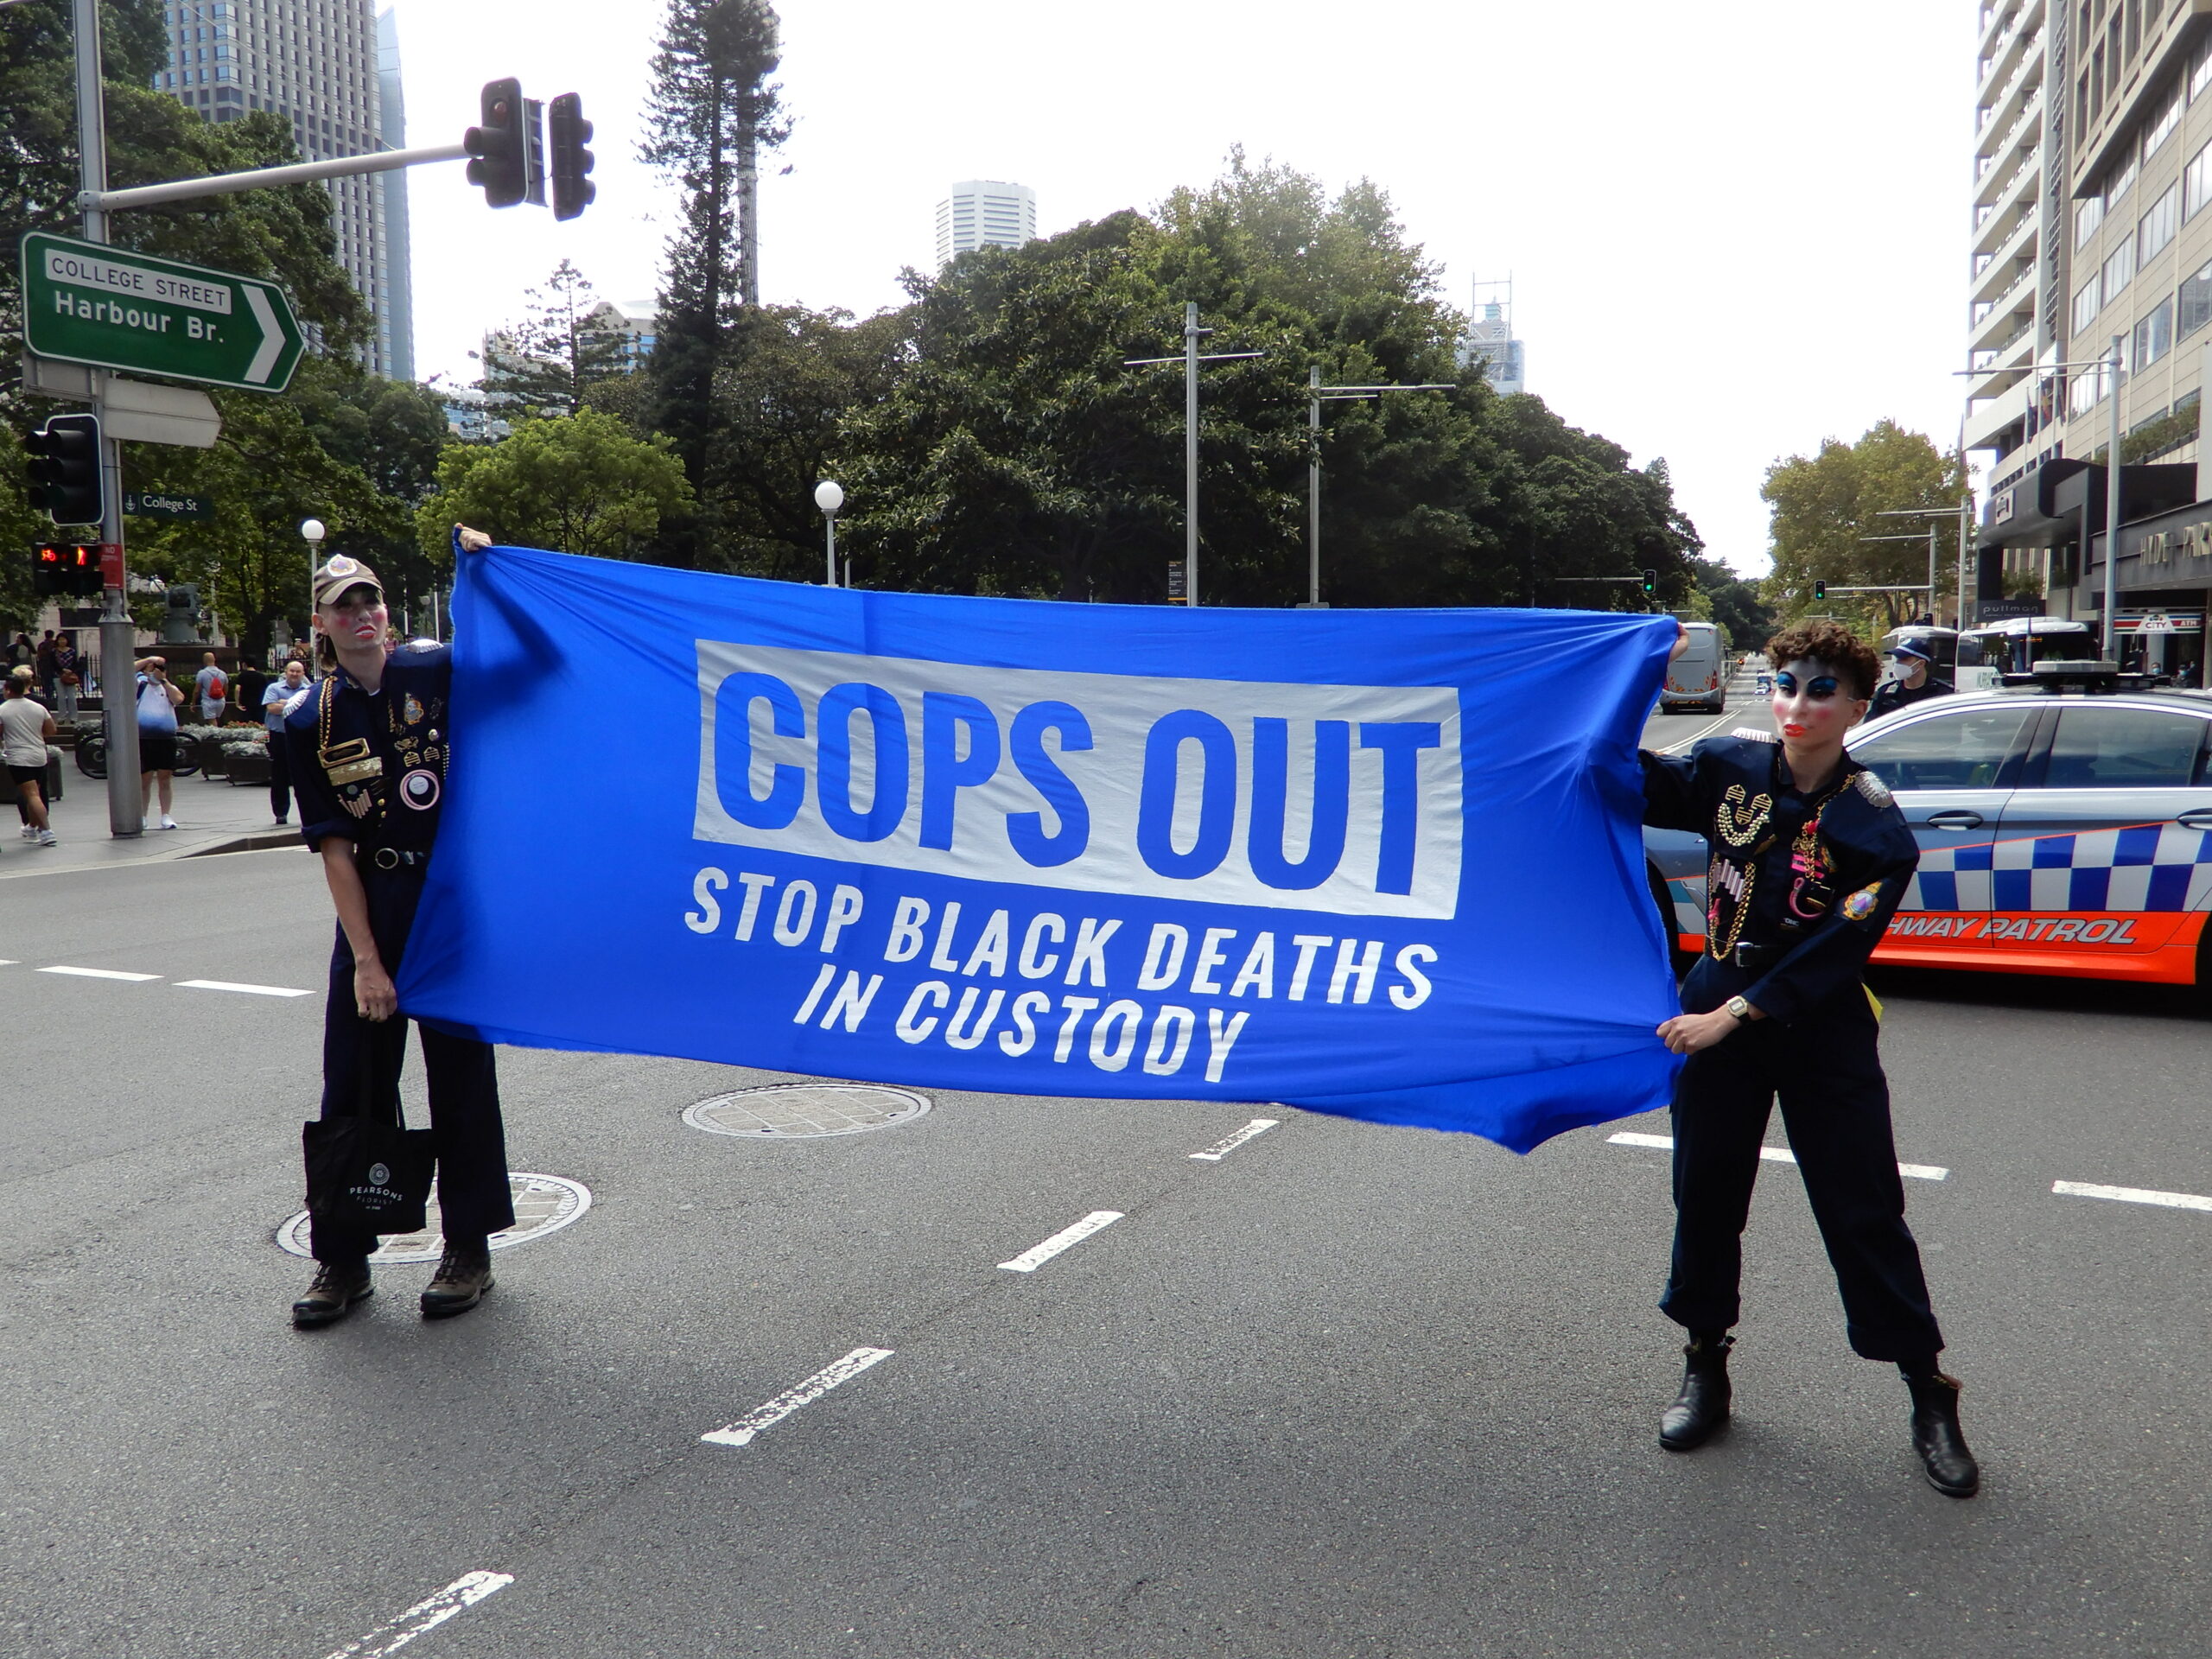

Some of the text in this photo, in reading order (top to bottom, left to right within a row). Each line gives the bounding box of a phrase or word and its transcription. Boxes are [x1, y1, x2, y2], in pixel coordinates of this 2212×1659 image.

[52, 257, 226, 307] COLLEGE STREET
[54, 290, 224, 343] Harbour Br.
[143, 495, 198, 512] College St
[2183, 522, 2212, 559] PAR
[1983, 605, 2039, 614] pullman
[715, 671, 1441, 896] COPS OUT
[684, 867, 1438, 1010] STOP BLACK DEATHS
[1977, 918, 2137, 944] PATROL
[793, 963, 1250, 1084] IN CUSTODY
[350, 1186, 403, 1201] PEARSONS
